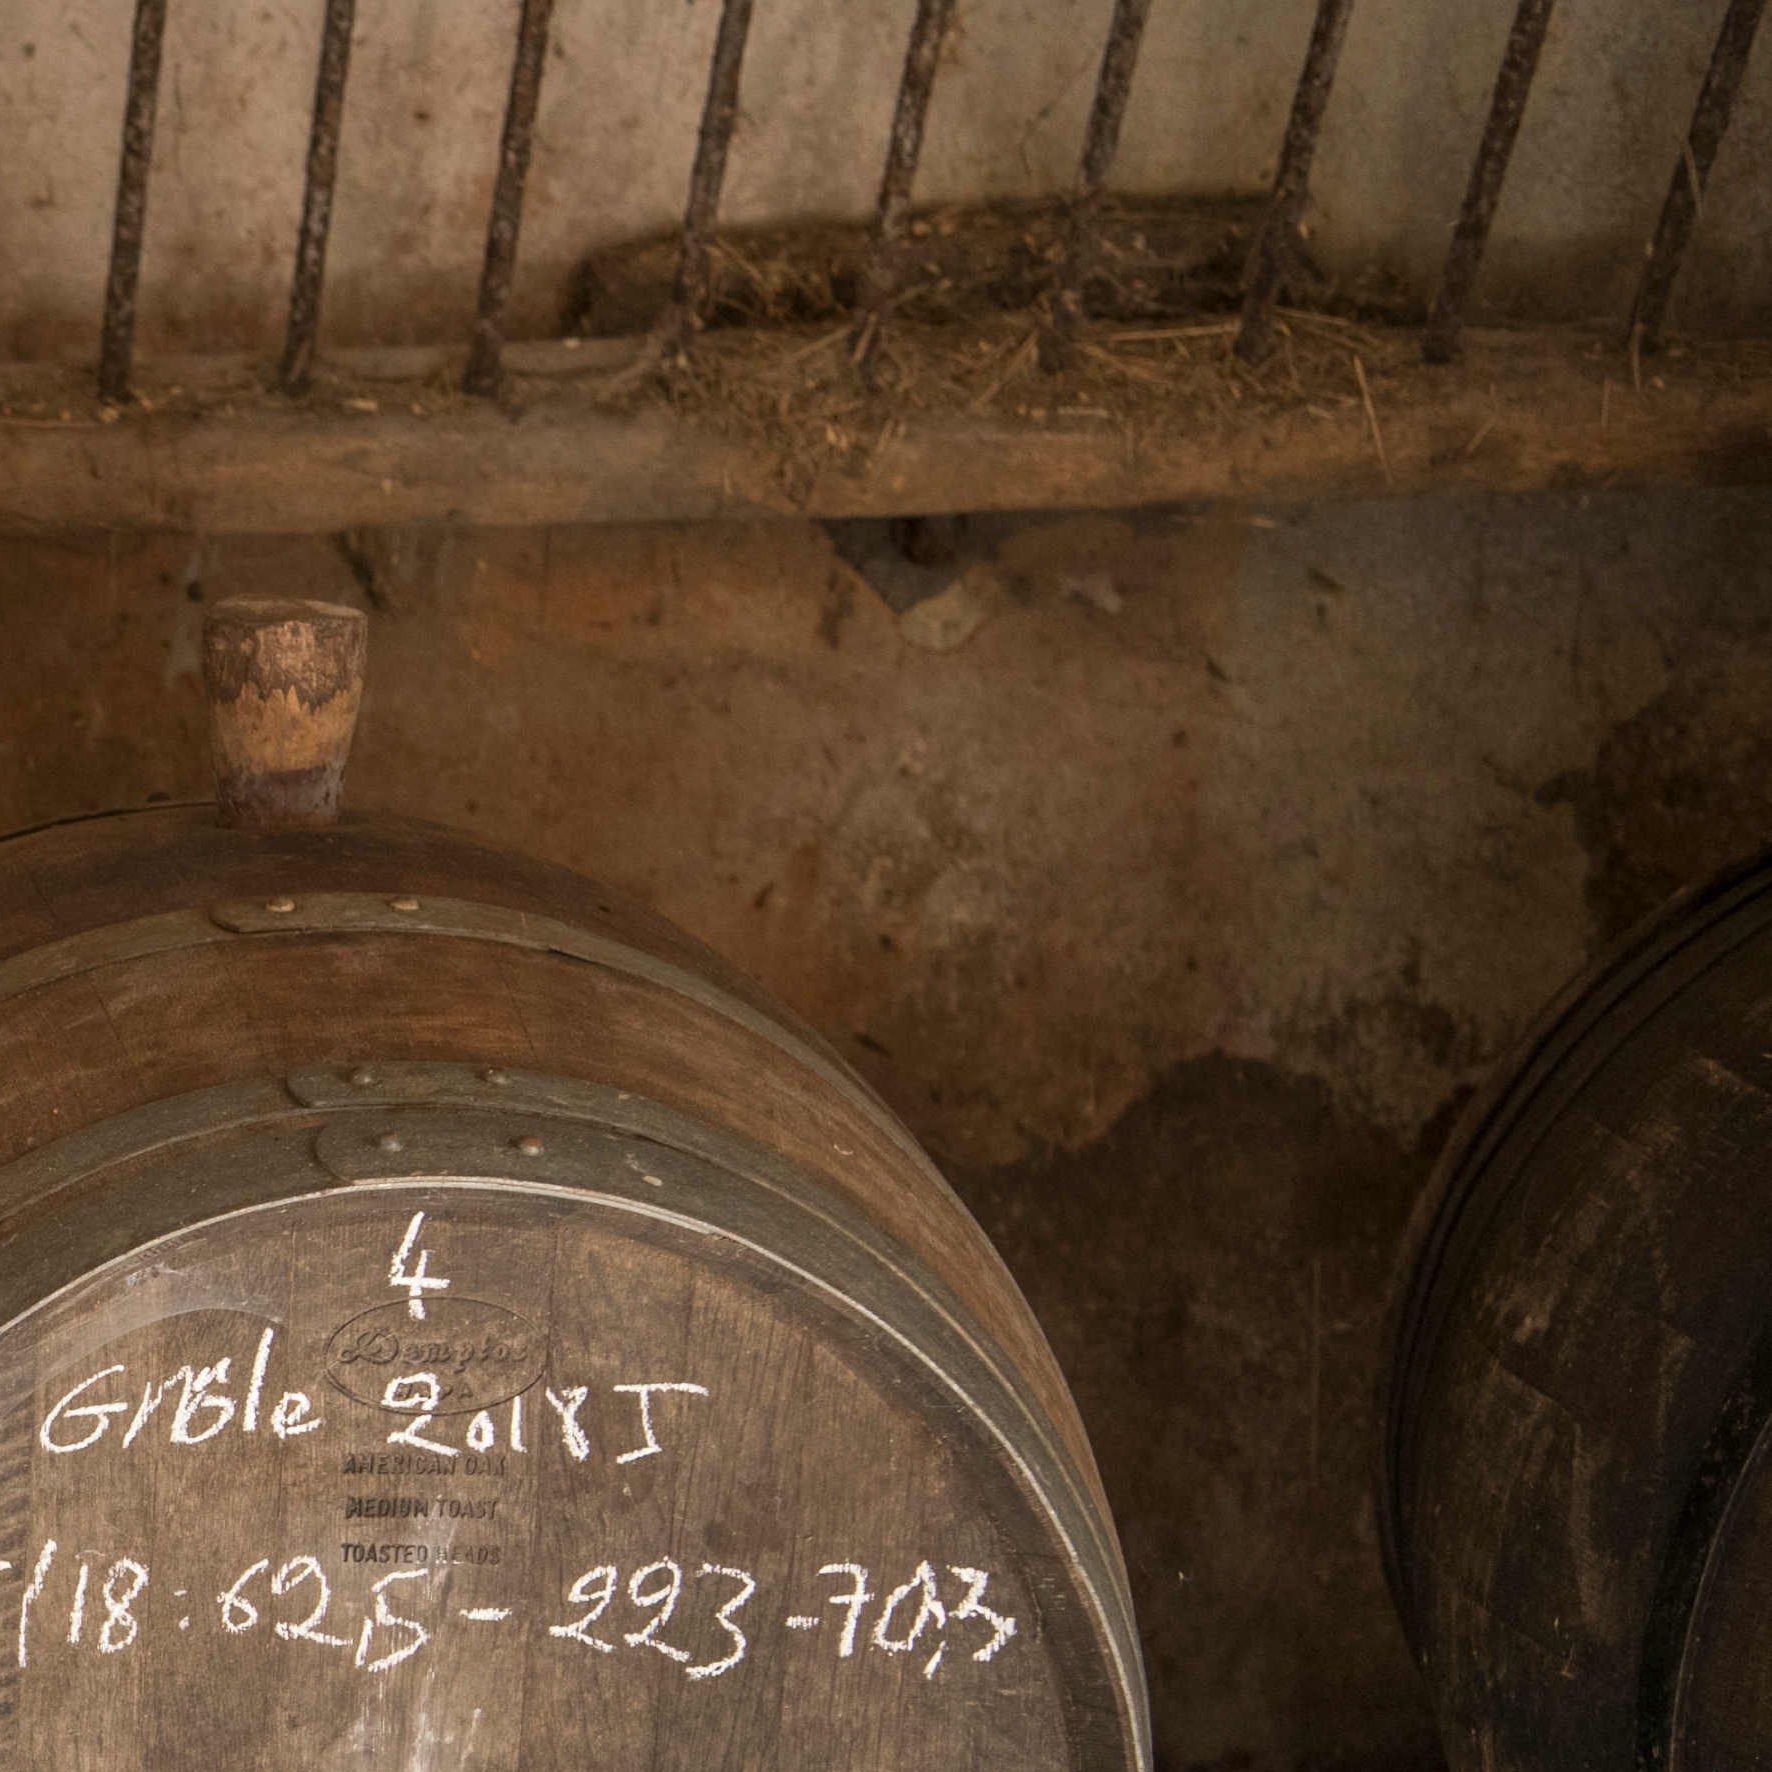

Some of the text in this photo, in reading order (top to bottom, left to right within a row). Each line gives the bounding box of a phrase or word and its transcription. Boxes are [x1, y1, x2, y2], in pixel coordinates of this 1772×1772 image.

[387, 1211, 450, 1320] 4
[342, 1452, 507, 1477] AMERICAN OAK
[345, 1496, 499, 1520] MEDIUM TOAST
[341, 1543, 502, 1565] TOASTED HEADS
[549, 1555, 756, 1679] 223
